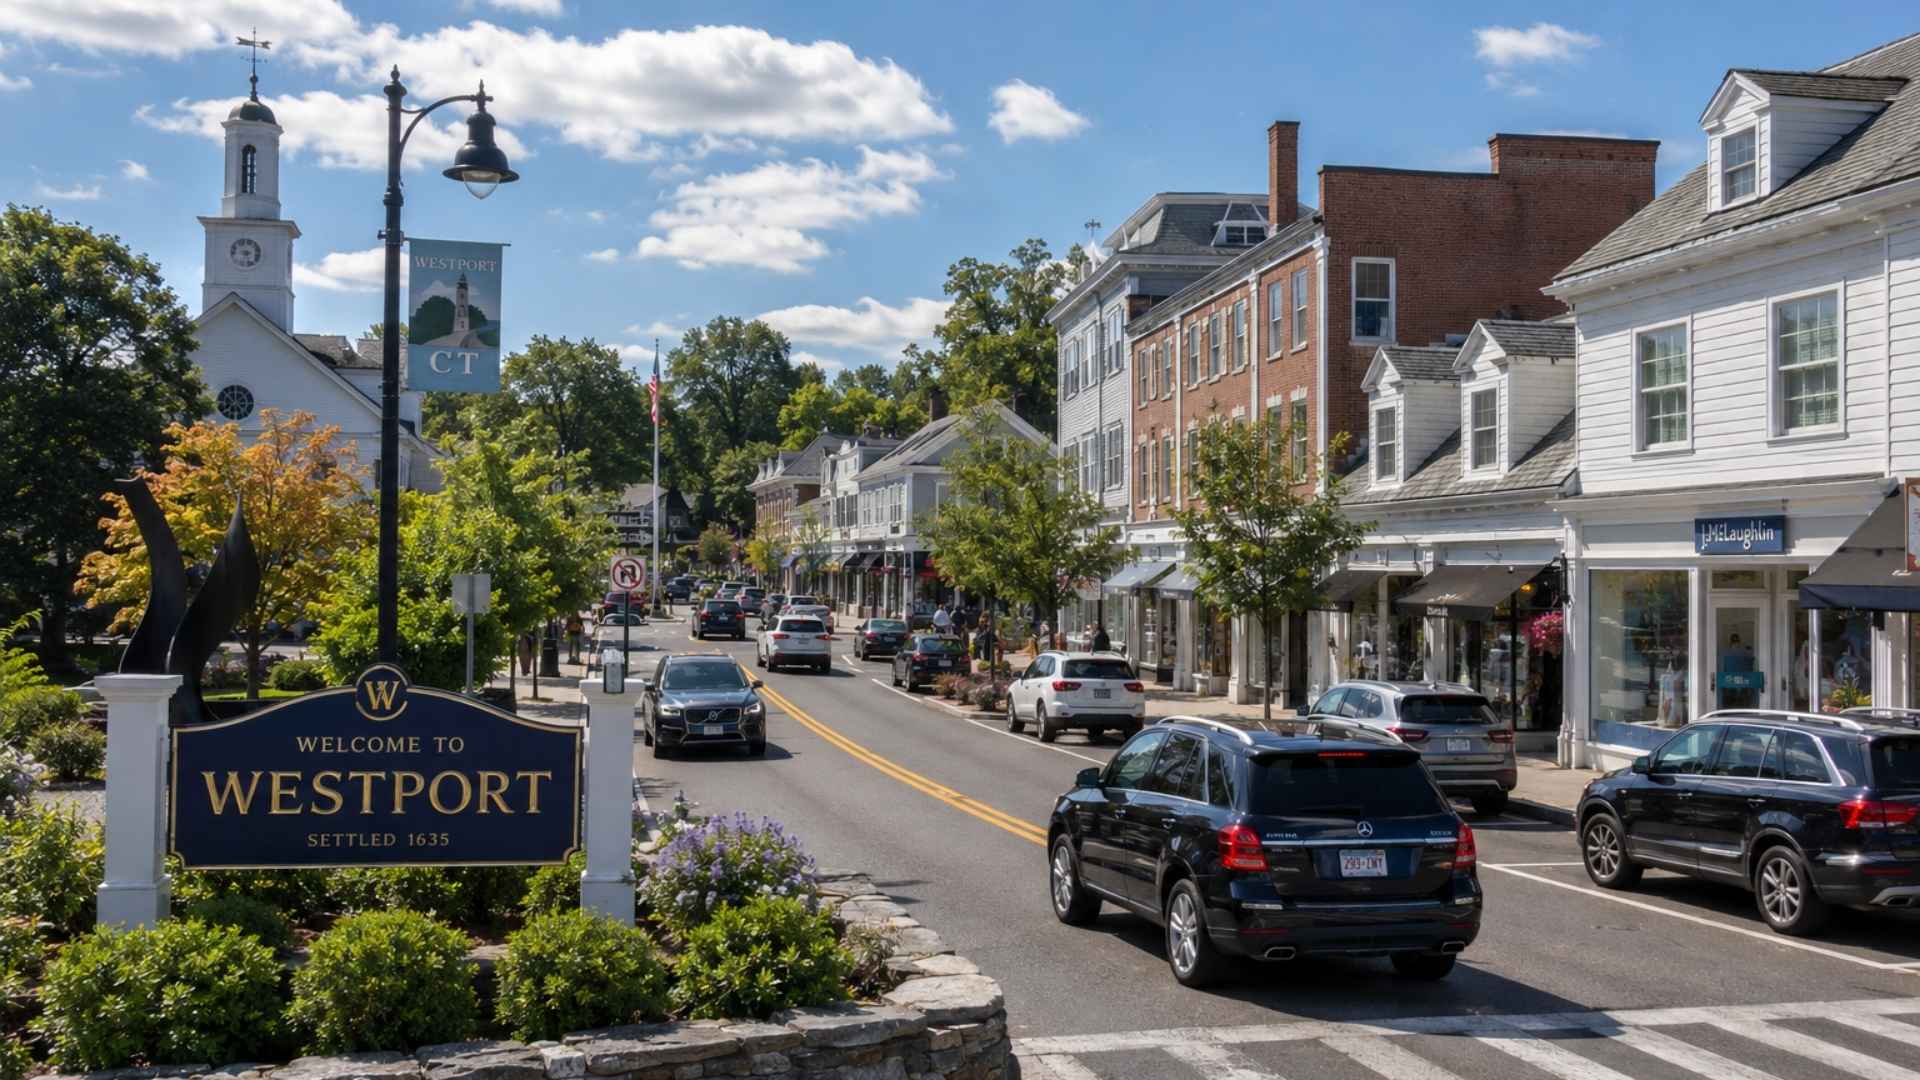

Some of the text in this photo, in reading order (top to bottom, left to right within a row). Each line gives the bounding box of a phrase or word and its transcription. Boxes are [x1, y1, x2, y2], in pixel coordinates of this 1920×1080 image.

[415, 255, 497, 272] WESTPORT
[430, 350, 480, 375] CT
[365, 680, 400, 711] W
[296, 736, 465, 753] WELCOME TO
[201, 770, 552, 815] WESTPORT
[307, 833, 450, 847] SETTLED 1635
